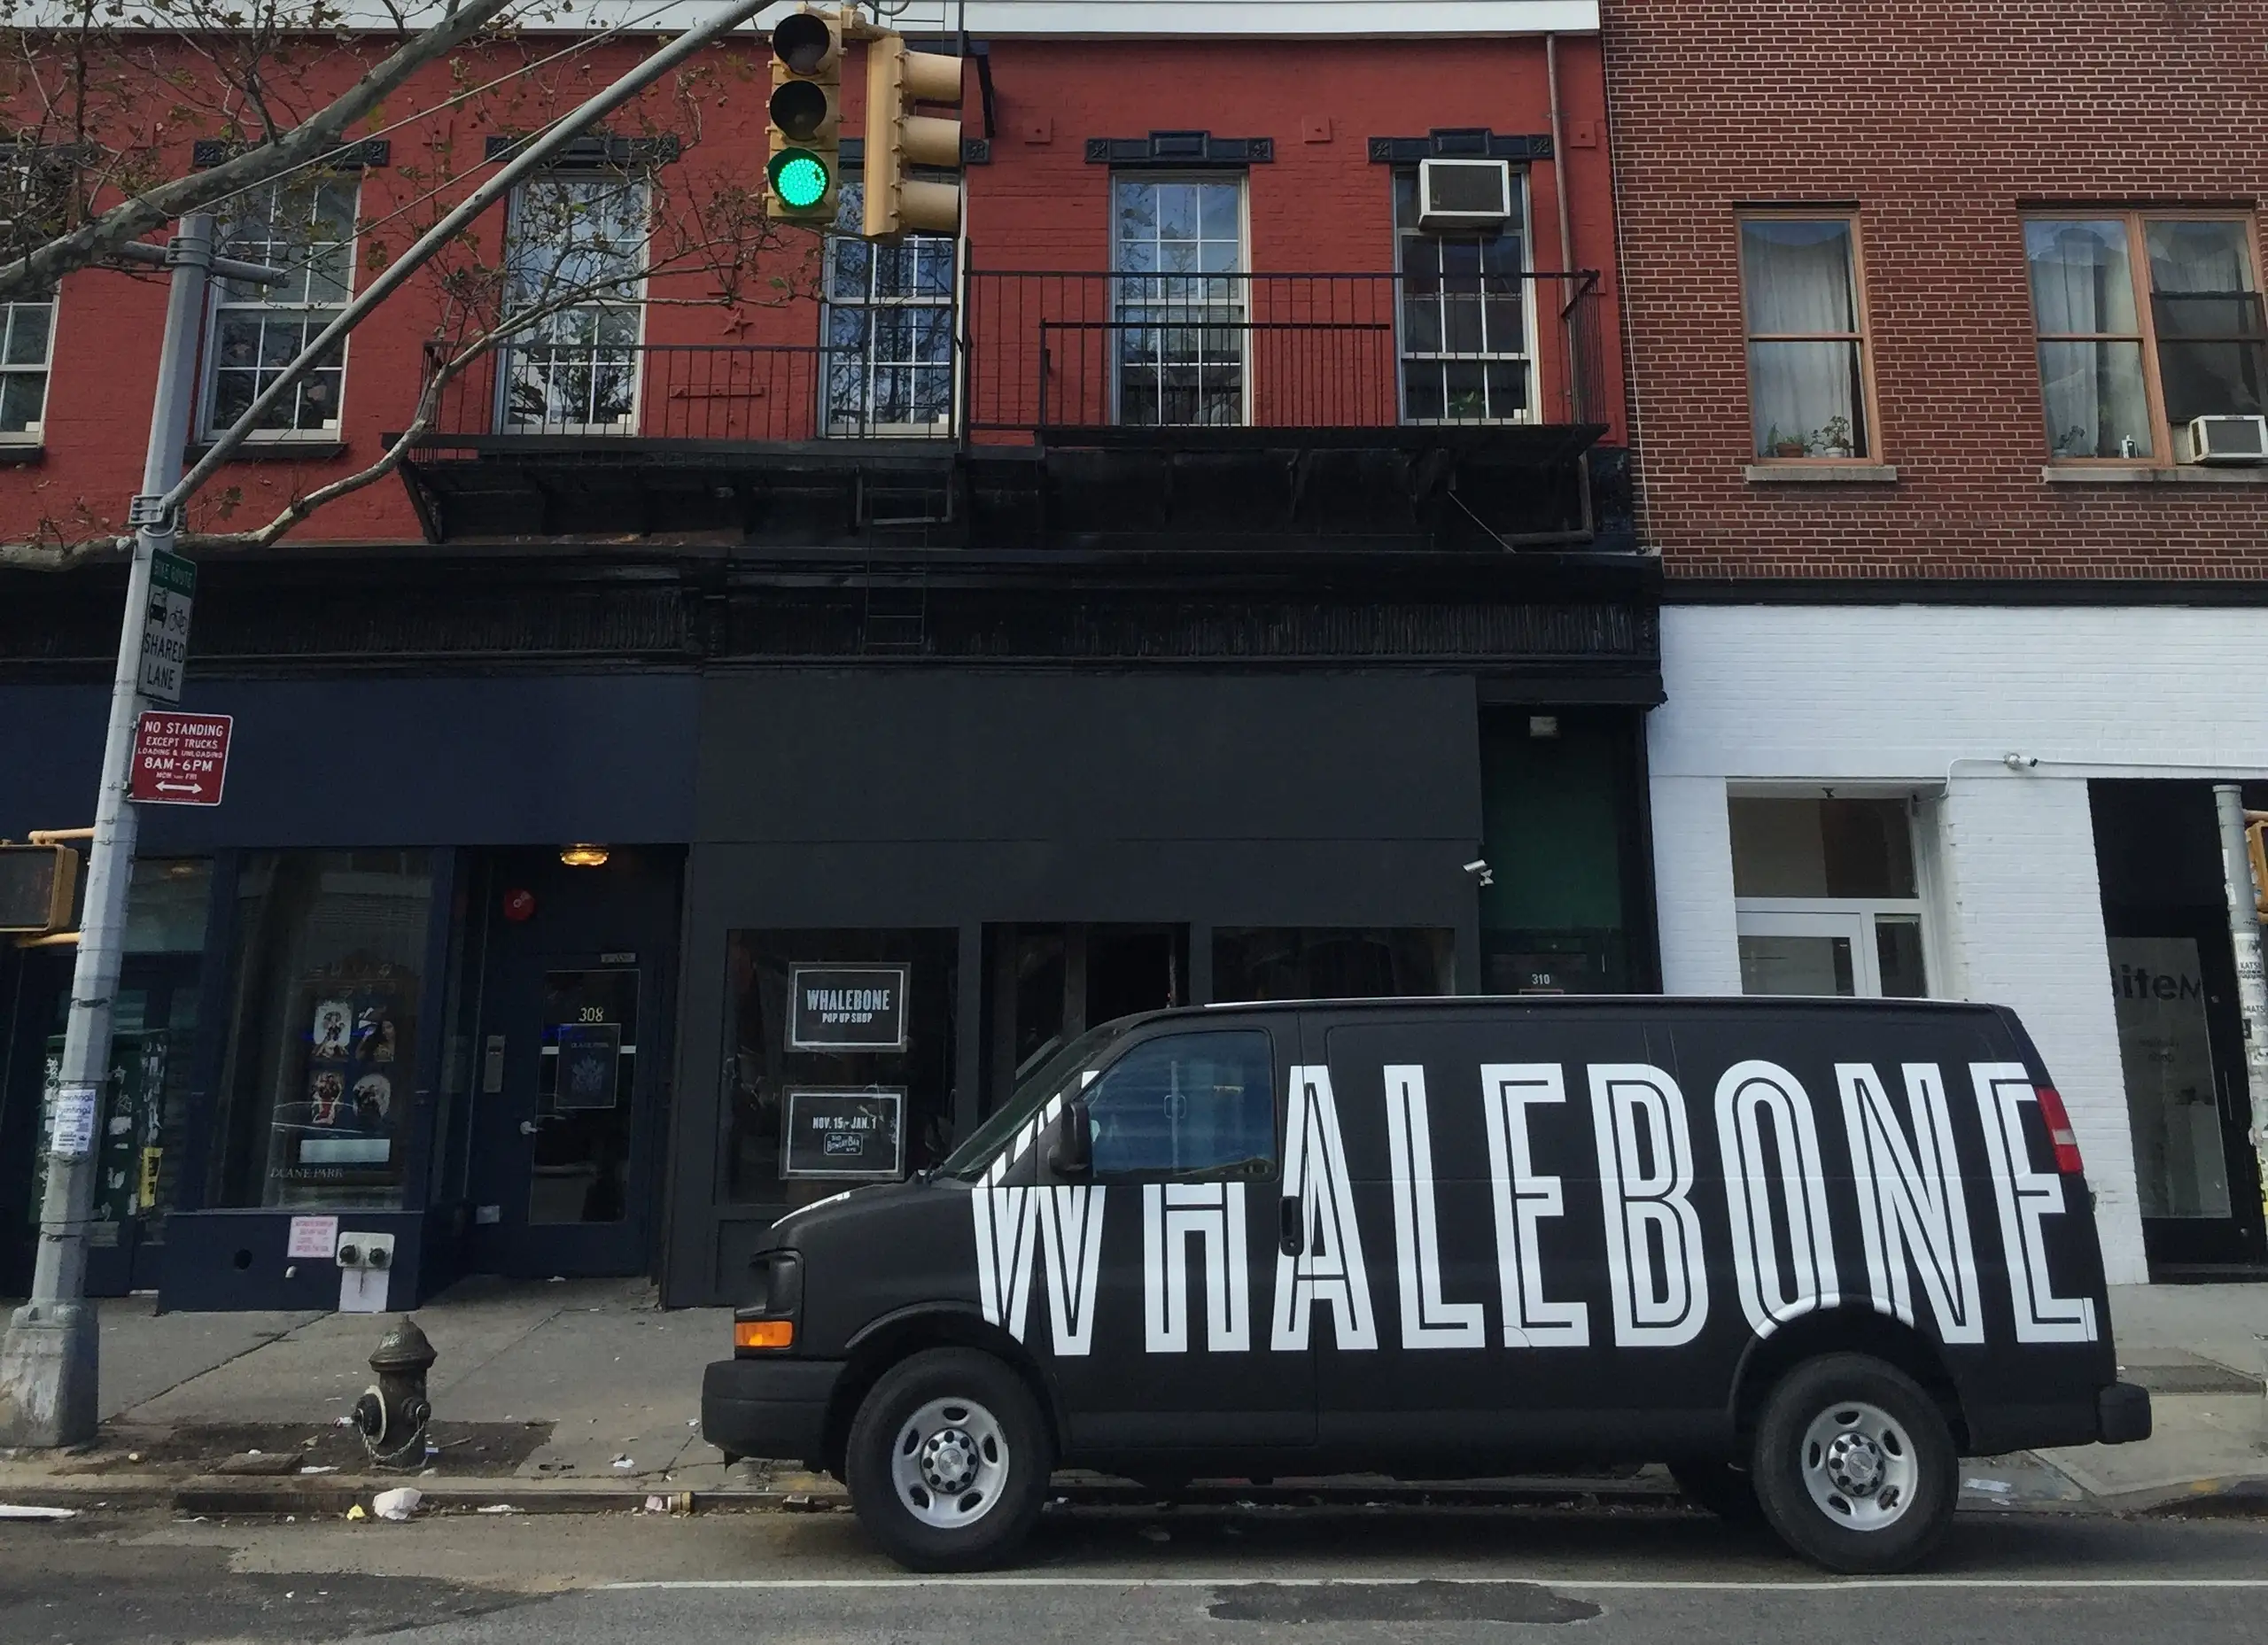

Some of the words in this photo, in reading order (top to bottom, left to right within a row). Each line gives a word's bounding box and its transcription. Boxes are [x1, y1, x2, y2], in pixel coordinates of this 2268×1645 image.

[144, 632, 185, 663] SHARED
[147, 663, 175, 690] LANE
[144, 721, 161, 733] NO
[166, 722, 224, 737] STANDING
[145, 736, 180, 748] EXCEPT
[184, 738, 218, 749] TRUCKS
[137, 747, 170, 757] LOADING
[144, 757, 213, 772] 8AM-6PM
[1531, 974, 1550, 985] 310
[2110, 965, 2202, 1002] iteM
[806, 989, 891, 1011] WHALEBONE
[579, 1007, 604, 1022] 308
[822, 1013, 837, 1023] POP
[839, 1013, 850, 1023] UP
[850, 1013, 873, 1023] SHOP
[812, 1116, 832, 1129] NOV.
[834, 1117, 843, 1129] 15
[850, 1116, 870, 1129] JAN.
[872, 1116, 876, 1129] 1
[270, 1168, 310, 1178] DUANE
[314, 1168, 344, 1178] PARK
[973, 1060, 2098, 1356] WHALEBONE
